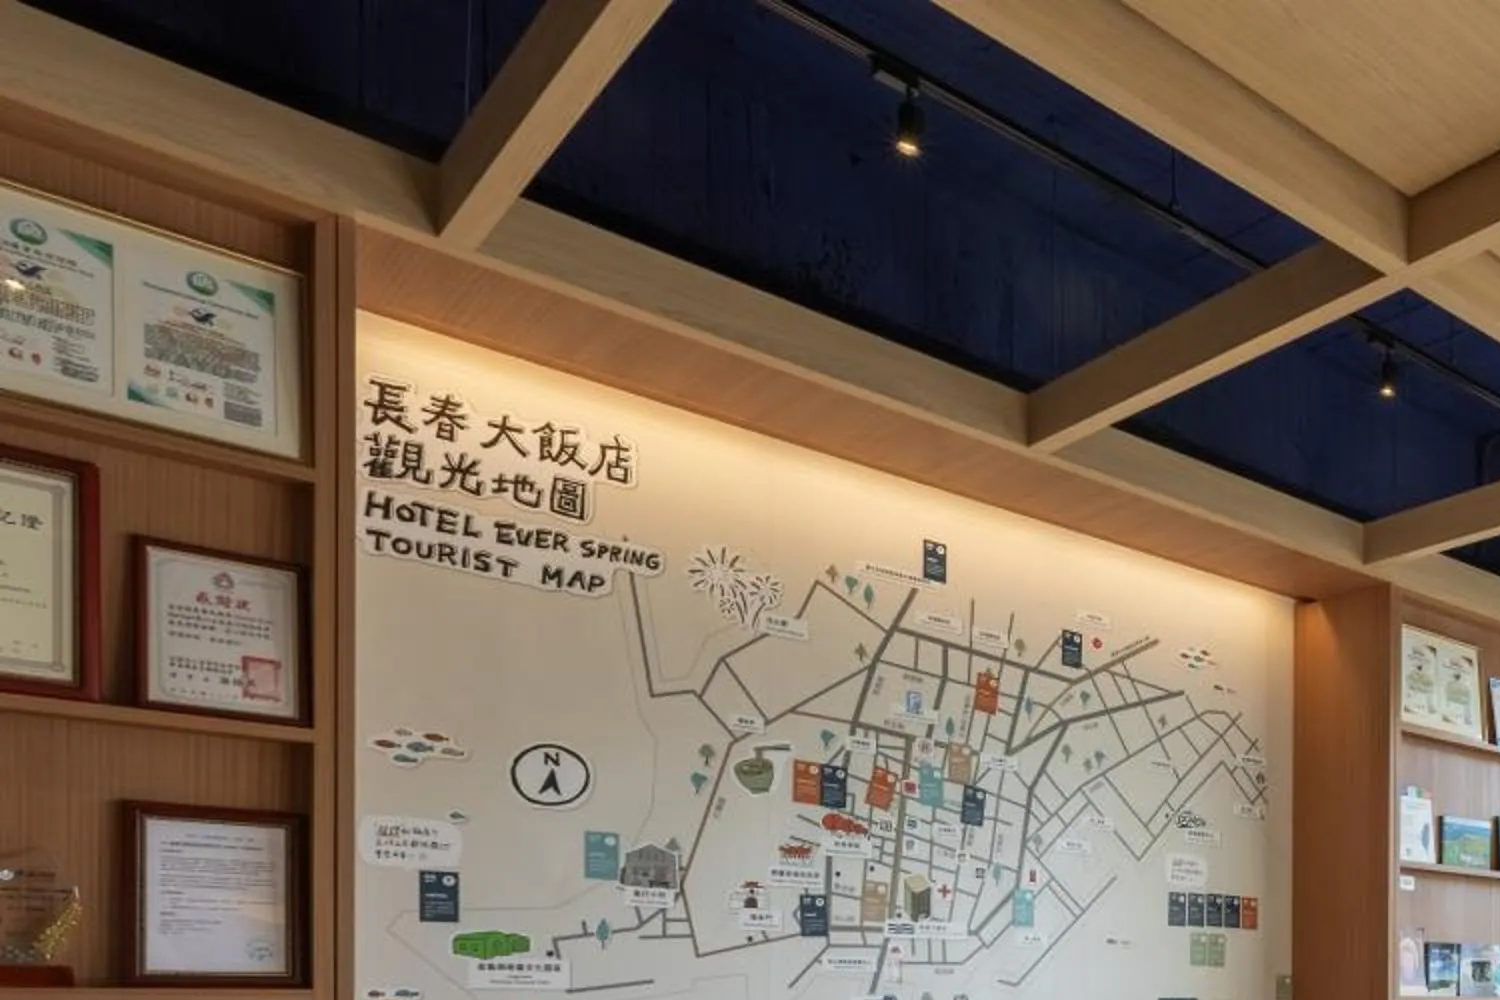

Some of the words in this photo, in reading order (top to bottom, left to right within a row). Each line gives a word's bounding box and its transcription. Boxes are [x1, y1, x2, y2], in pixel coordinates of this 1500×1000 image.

[364, 379, 631, 484] 長春大飯店
[363, 431, 587, 521] 觀光地圖
[366, 528, 519, 579] TOURIST
[541, 564, 606, 594] MAP
[494, 519, 570, 554] EVER
[580, 539, 660, 571] SPRING
[543, 751, 561, 767] N
